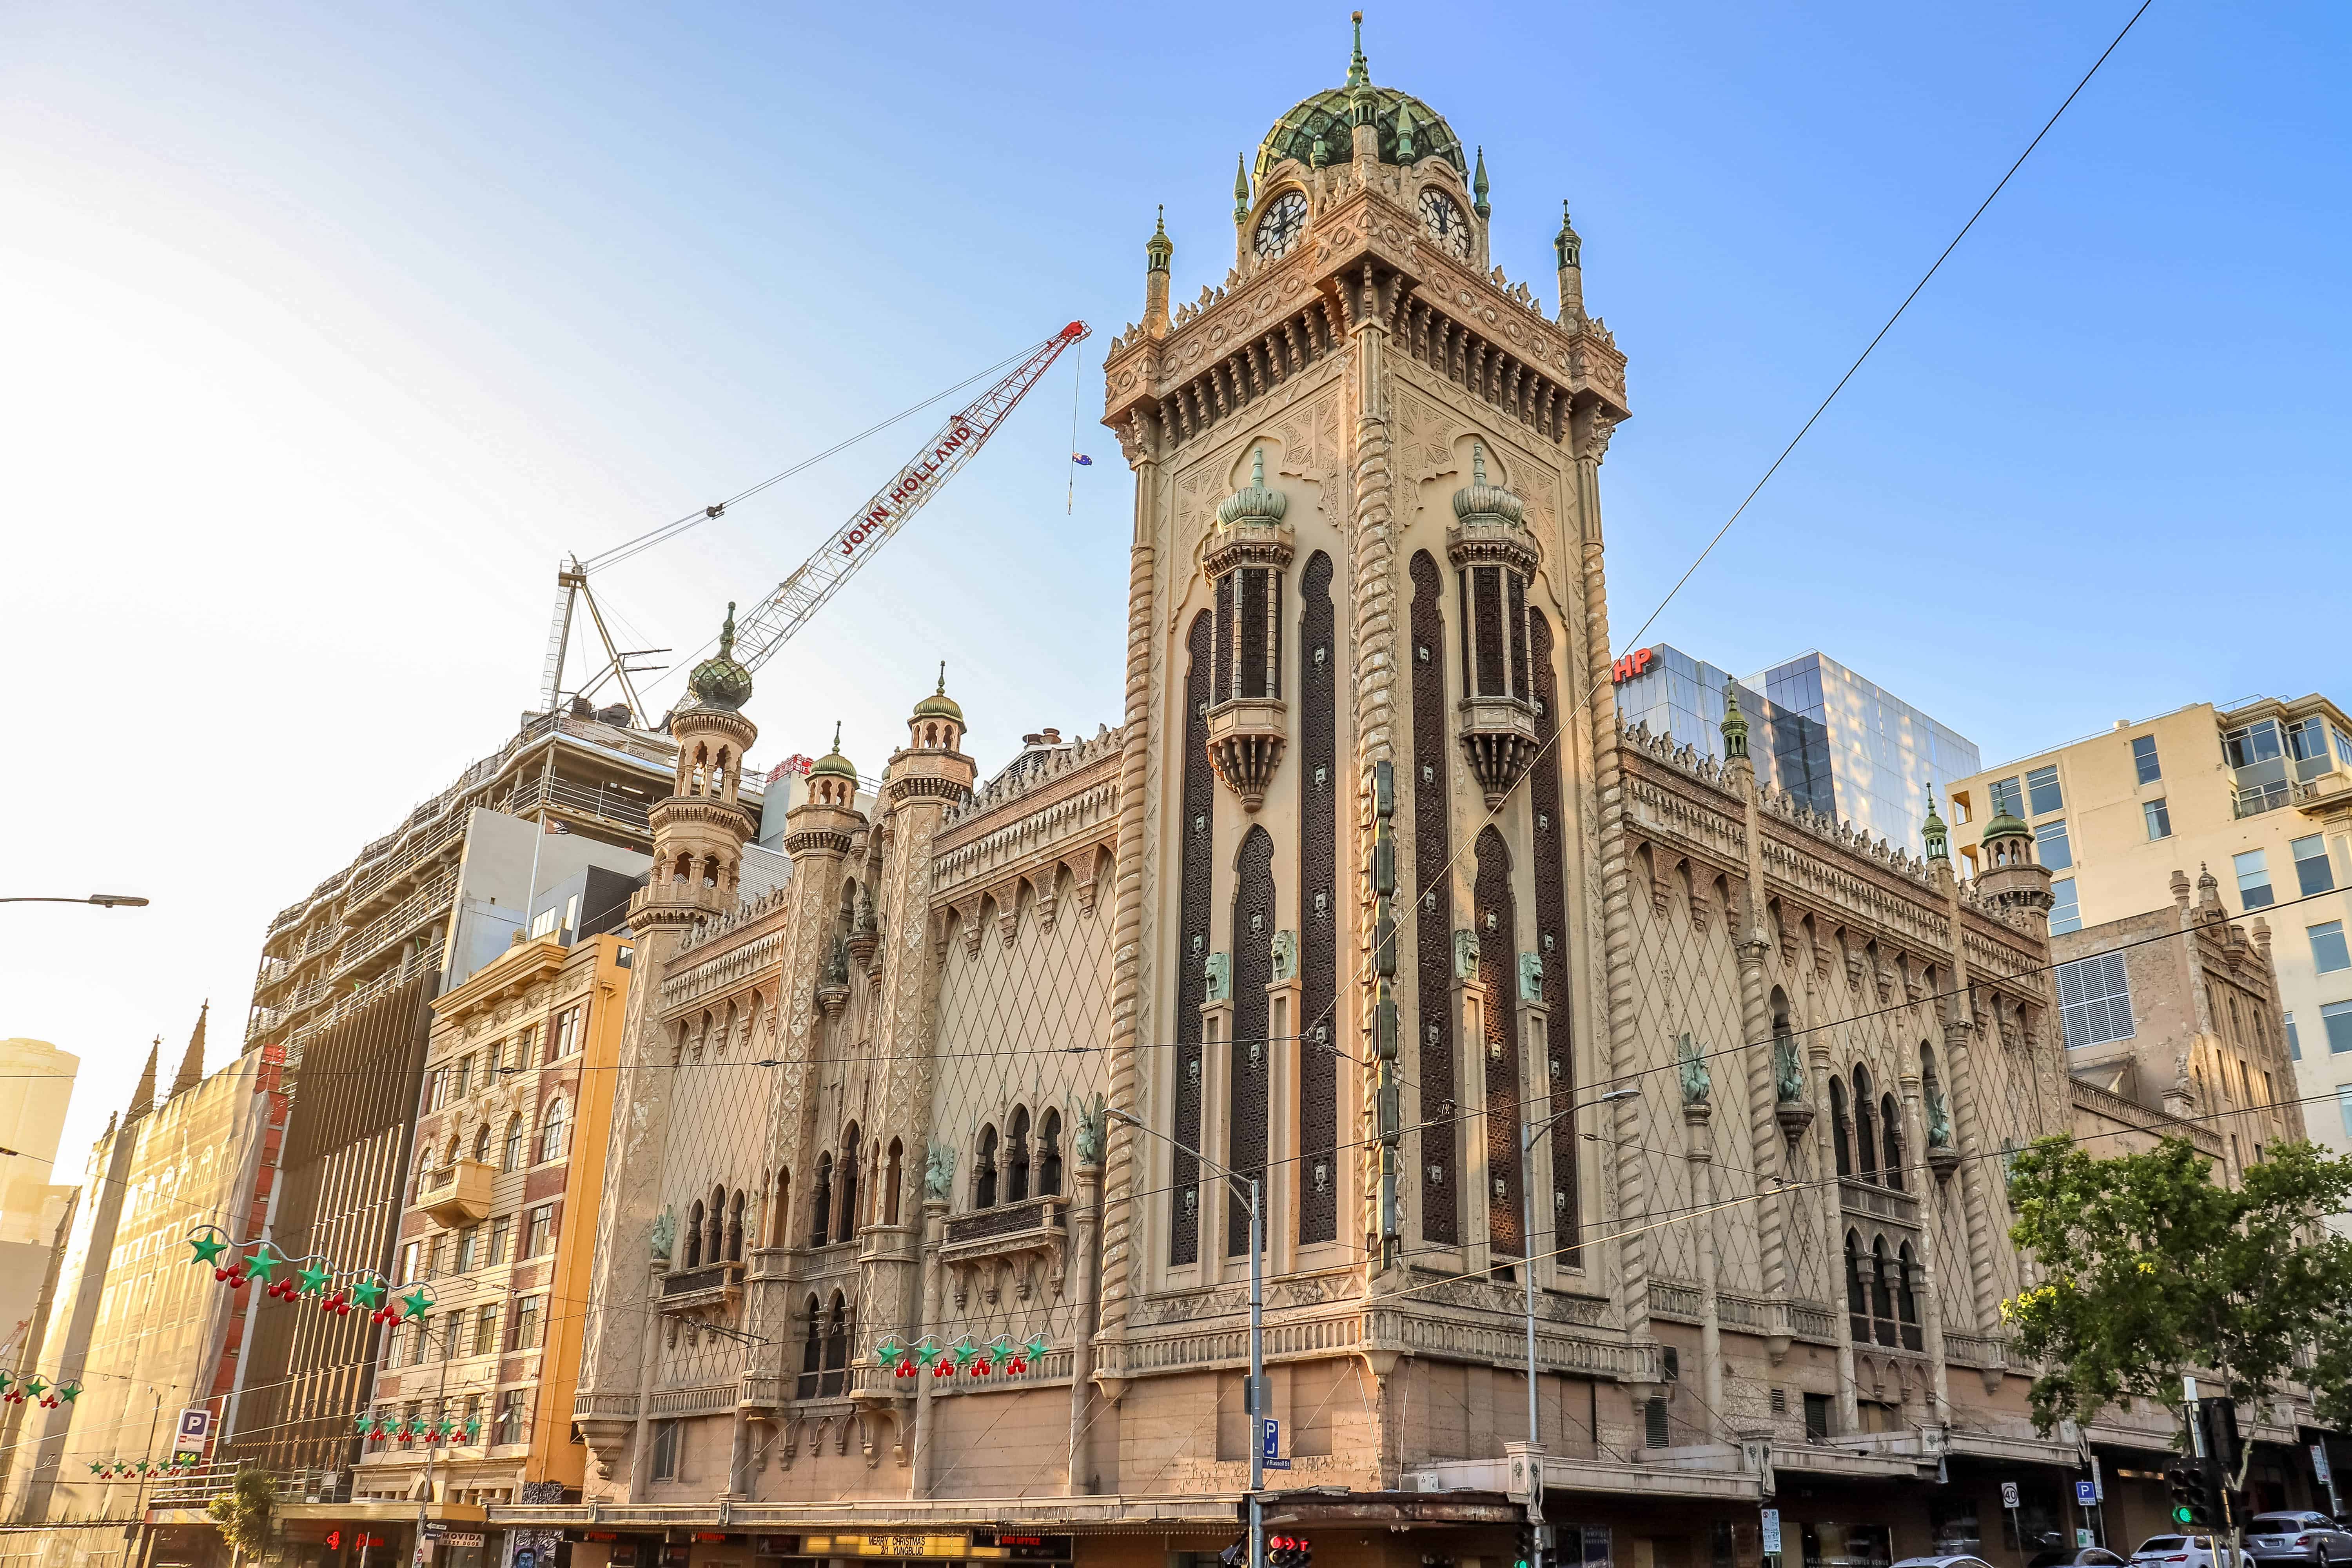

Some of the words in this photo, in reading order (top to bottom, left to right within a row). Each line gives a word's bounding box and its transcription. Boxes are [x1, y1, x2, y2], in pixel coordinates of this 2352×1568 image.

[842, 506, 890, 555] JOHN
[889, 426, 970, 505] HOLLAND
[628, 748, 645, 757] SELECT
[187, 1416, 202, 1430] P
[1267, 1422, 1276, 1439] P
[2005, 1490, 2016, 1499] 40
[2081, 1485, 2089, 1496] P
[869, 1537, 888, 1545] MERRY
[892, 1537, 925, 1546] CHRISTMAS
[1016, 1537, 1041, 1545] OFFICE
[893, 1547, 924, 1555] YUNGBLUD
